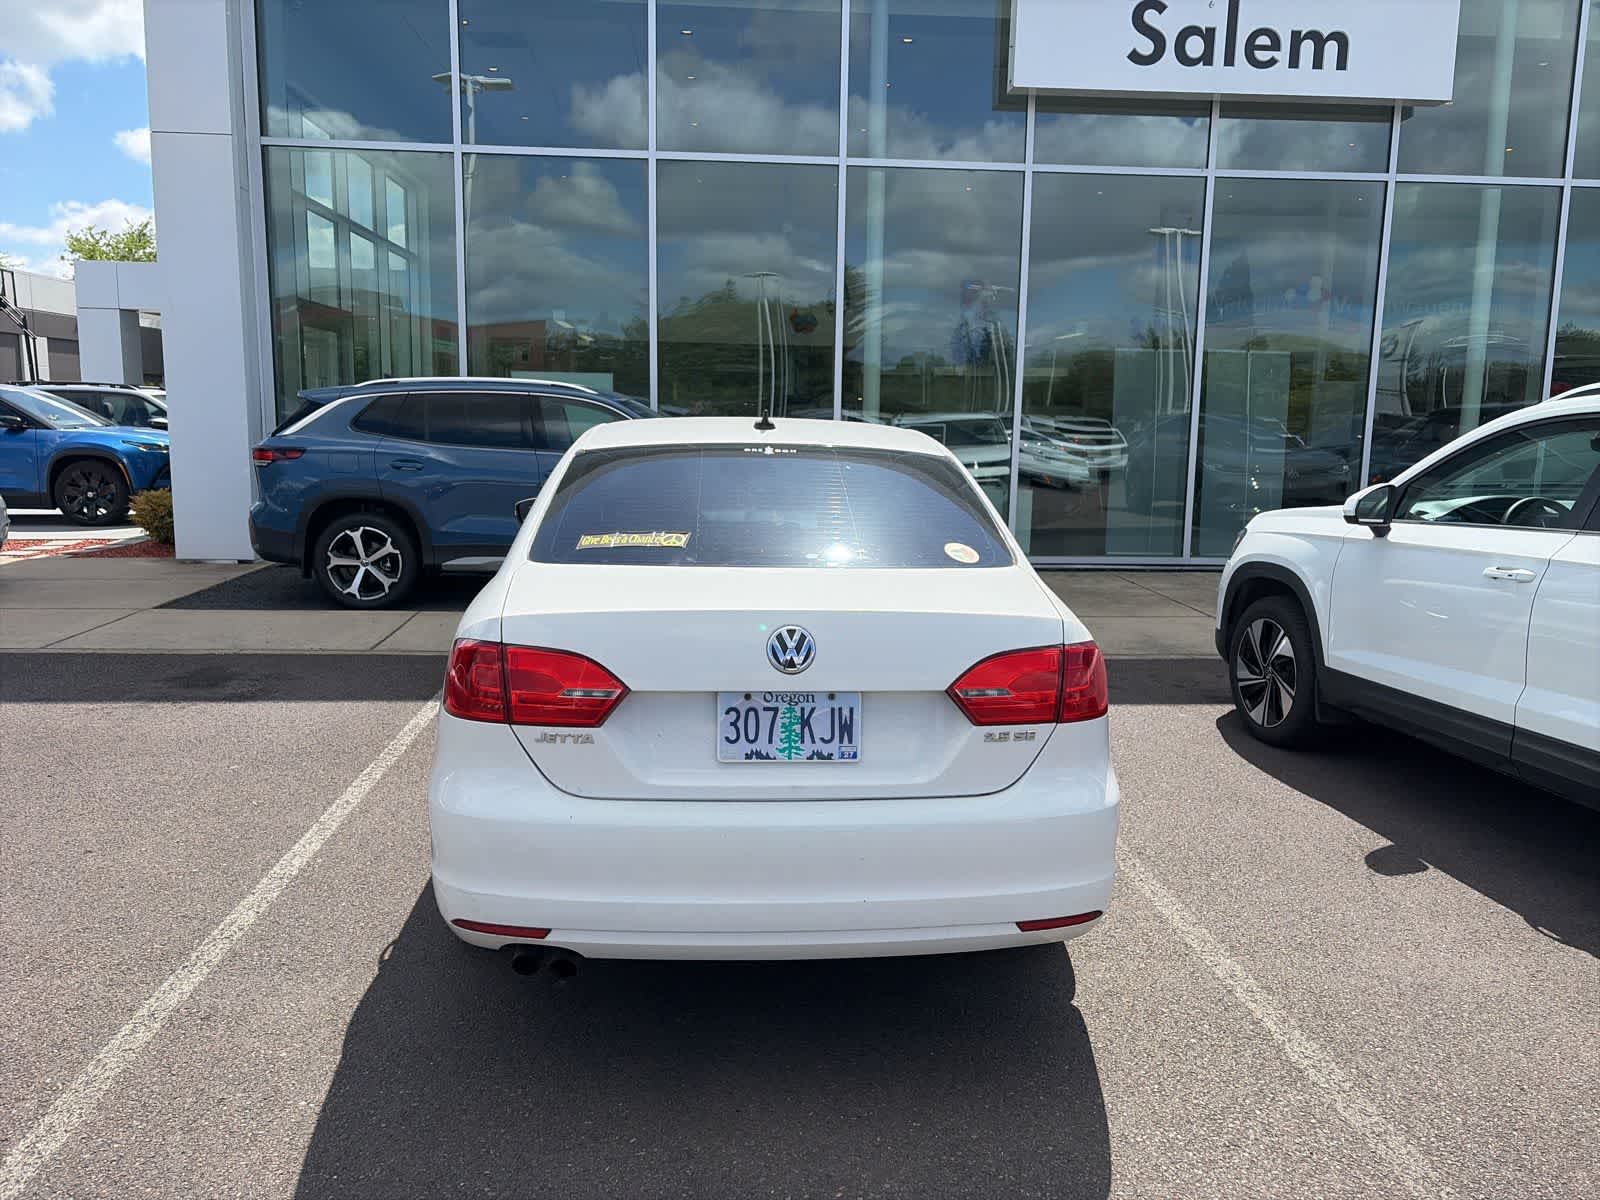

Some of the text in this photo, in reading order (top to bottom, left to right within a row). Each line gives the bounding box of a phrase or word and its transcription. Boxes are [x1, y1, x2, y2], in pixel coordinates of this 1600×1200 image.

[1127, 0, 1350, 71] Salem
[763, 691, 816, 706] Oregon
[535, 733, 595, 745] JETTA
[725, 706, 855, 745] 307 KJW
